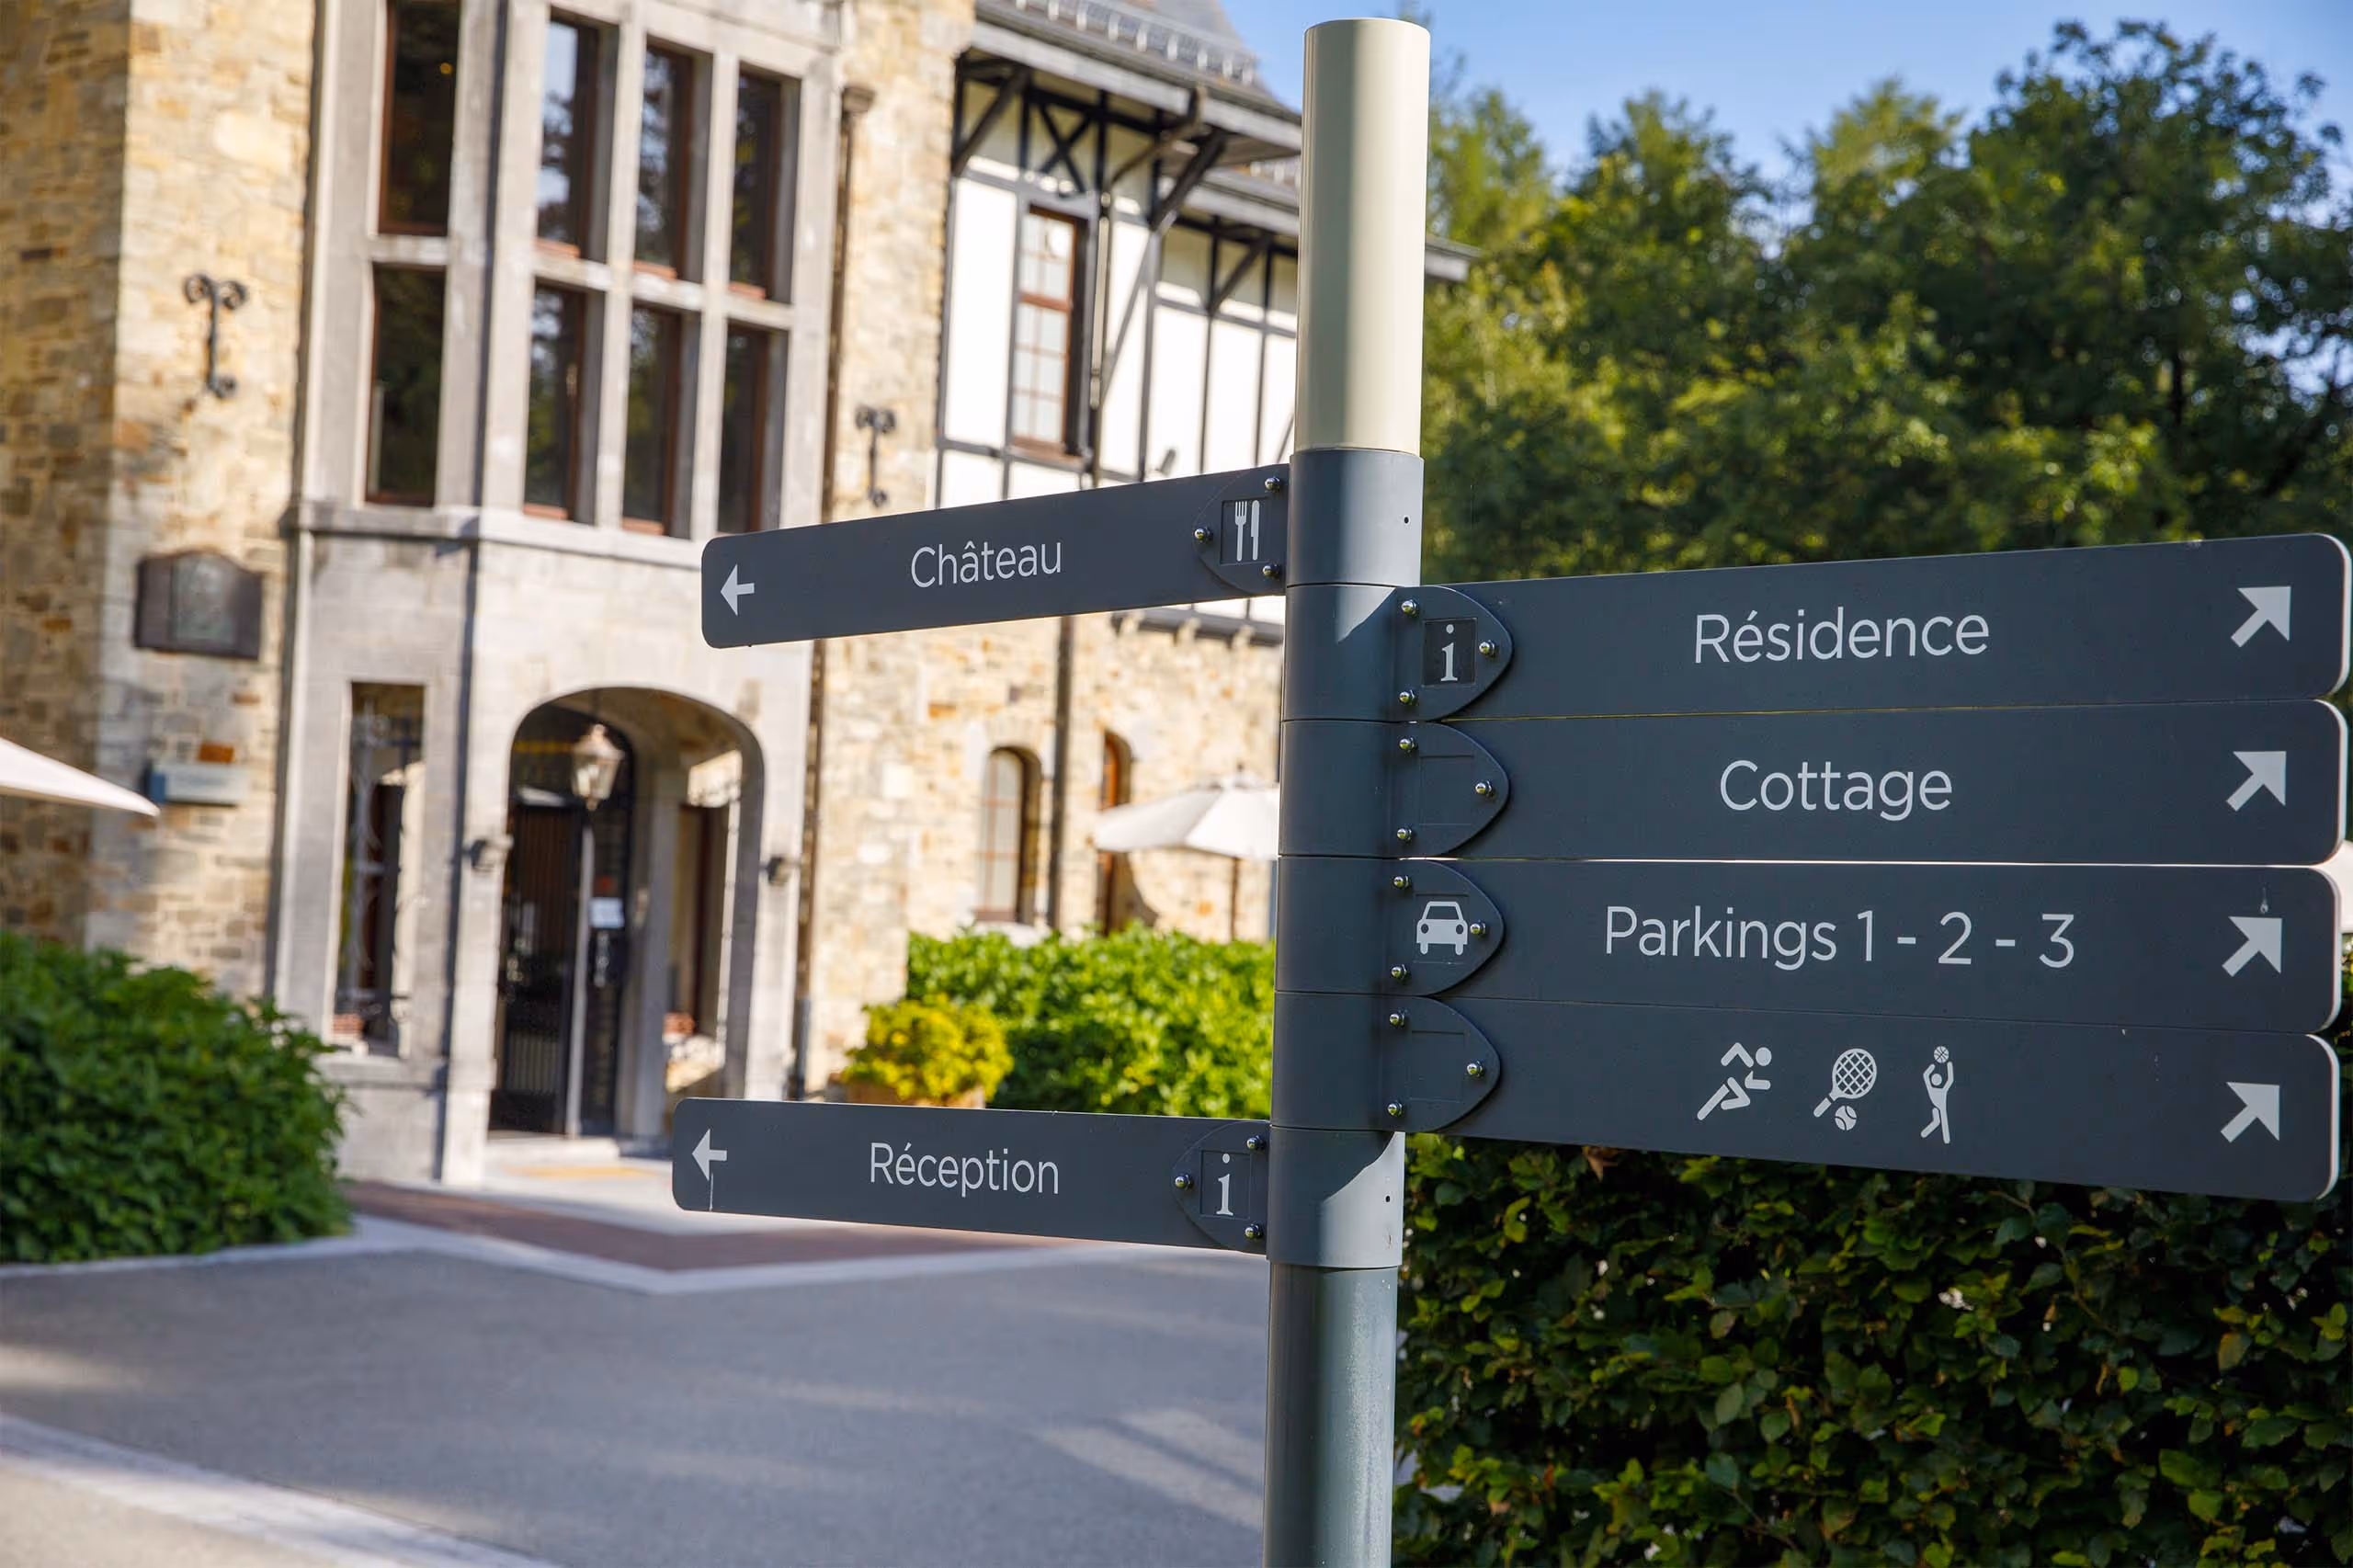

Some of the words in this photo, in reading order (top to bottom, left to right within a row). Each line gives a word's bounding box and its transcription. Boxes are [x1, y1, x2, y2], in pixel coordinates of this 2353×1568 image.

[911, 539, 1063, 588] Château
[1694, 606, 1991, 665] Résidence
[1719, 758, 1953, 823] Cottage
[1605, 903, 1838, 971] Parkings
[1937, 910, 1973, 966] 2
[2038, 912, 2075, 970] 3
[870, 1141, 1060, 1199] Réception
